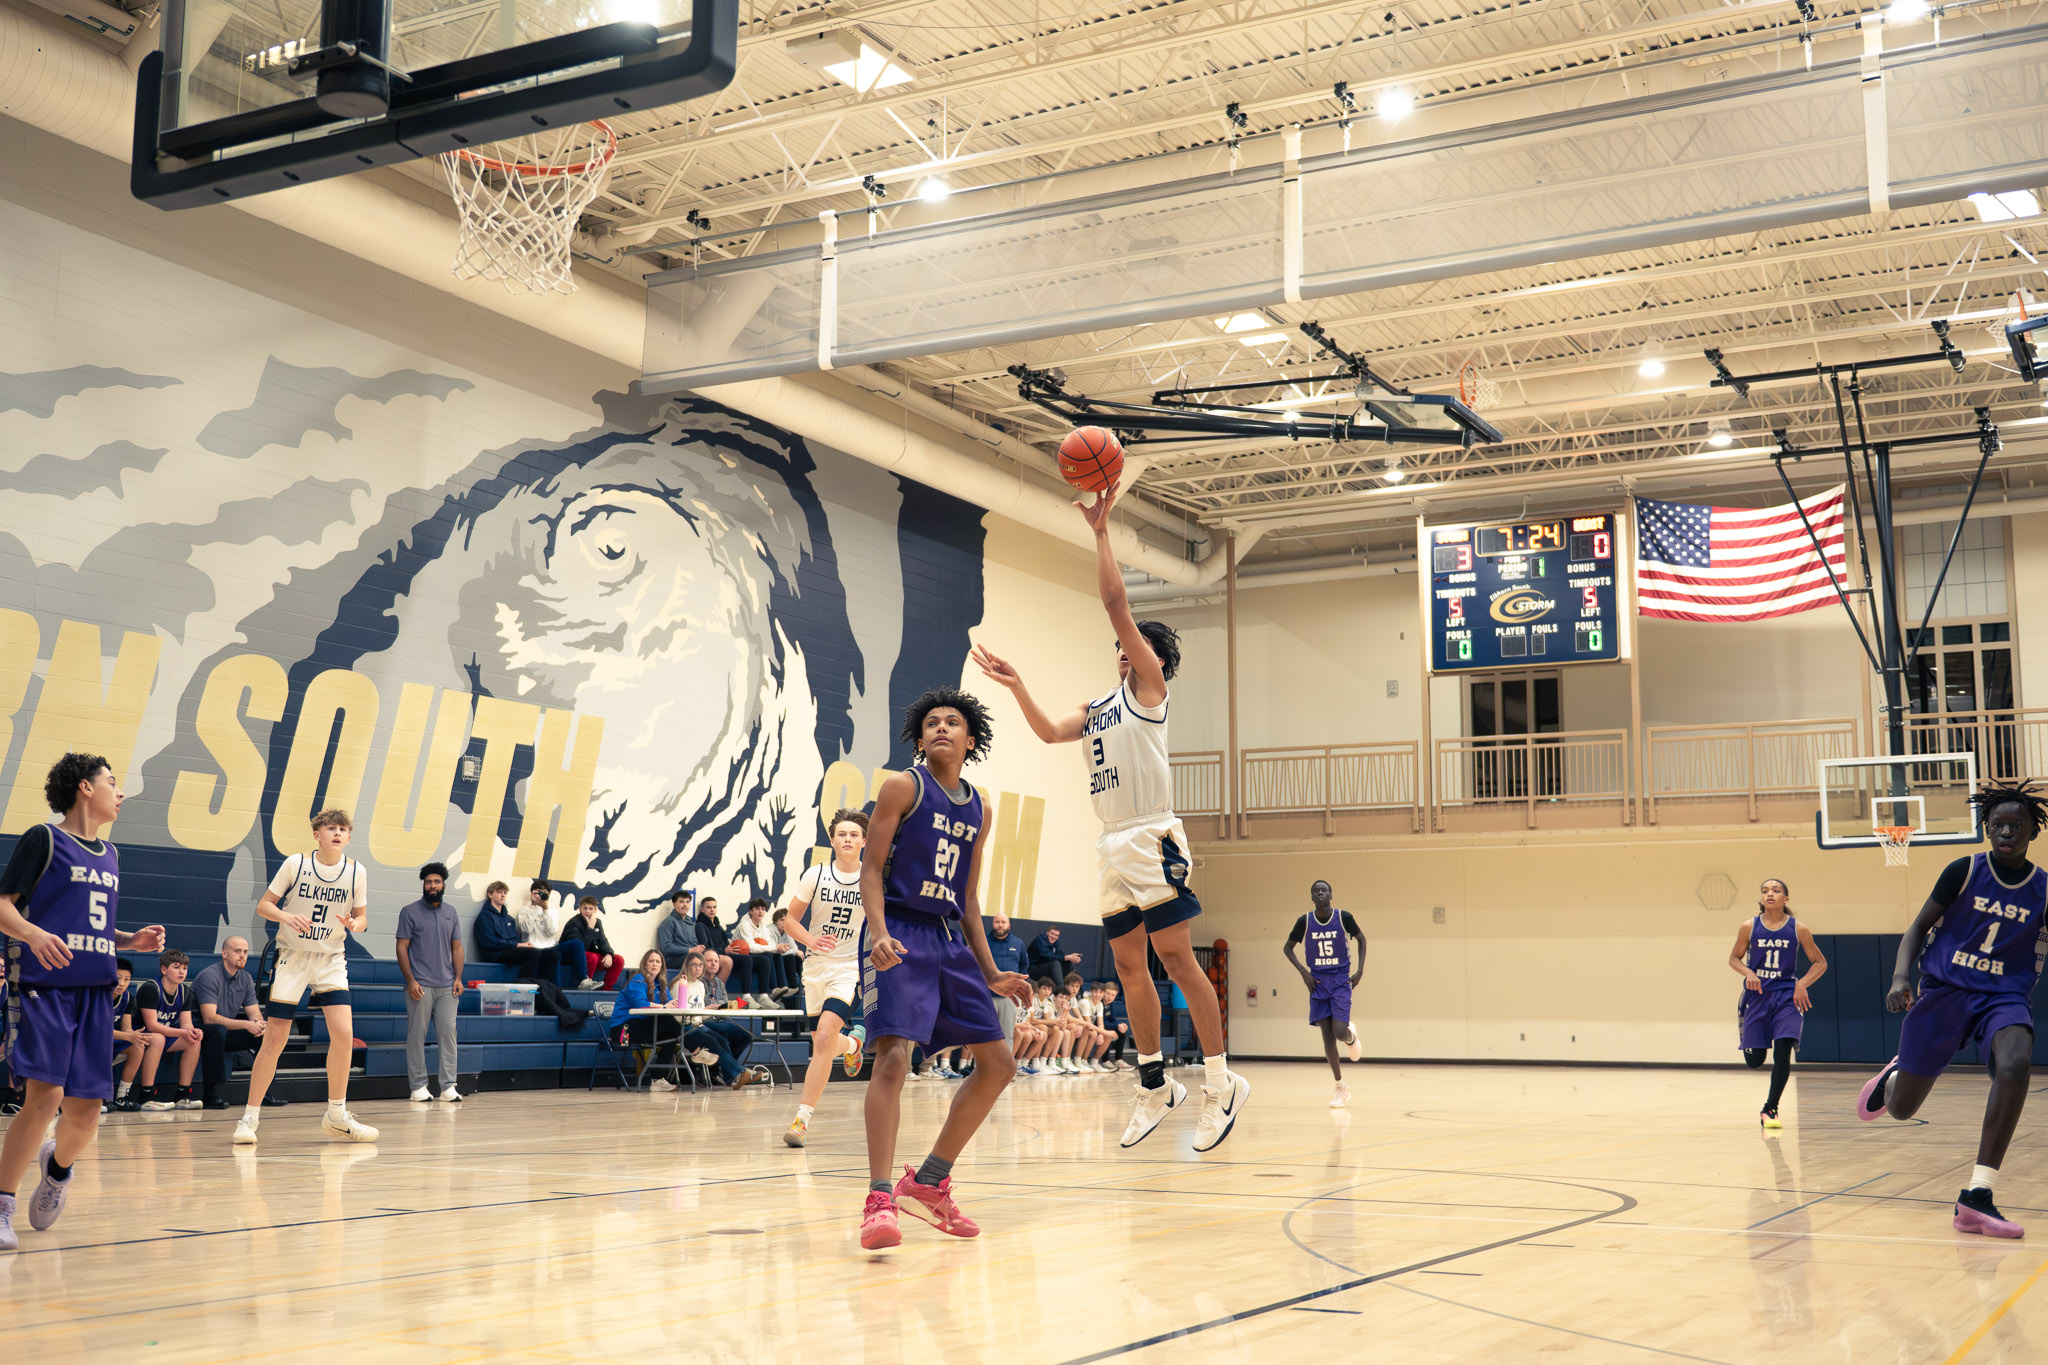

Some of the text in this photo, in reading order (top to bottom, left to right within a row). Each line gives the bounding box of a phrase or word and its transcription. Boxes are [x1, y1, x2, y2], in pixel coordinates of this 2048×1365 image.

[1498, 523, 1560, 550] 7:24
[1594, 532, 1610, 558] 0
[1456, 546, 1472, 570] 3
[1498, 562, 1528, 574] PERIOD
[1567, 562, 1596, 574] BONUS
[1449, 572, 1476, 584] BONUS
[1569, 576, 1611, 588] TIMEOUTS
[1436, 588, 1476, 599] TIMEOUTS
[1584, 587, 1598, 608] 5
[1450, 598, 1462, 618] 5
[1518, 600, 1555, 612] STORM
[1580, 607, 1600, 618] LEFT
[1446, 618, 1466, 628] LEFT
[1496, 624, 1558, 636] PLAYER FOULS
[1575, 620, 1602, 631] FOULS
[1446, 630, 1472, 640] FOULS
[1589, 630, 1602, 651] 0
[1459, 640, 1472, 660] 0
[1092, 737, 1104, 766] 3
[168, 654, 605, 882] SOUTH
[934, 838, 960, 882] 20
[298, 882, 349, 904] ELKHORN
[820, 888, 864, 906] ELKHOR
[89, 890, 108, 930] 5
[312, 904, 328, 924] 21
[830, 906, 852, 924] 23
[1974, 896, 2030, 923] EAST
[1312, 931, 1338, 940] EAST
[1758, 939, 1790, 948] EAST
[1979, 921, 2000, 954] 1
[1318, 940, 1334, 956] 15
[1764, 950, 1780, 968] 11
[1952, 950, 2004, 976] HIGH
